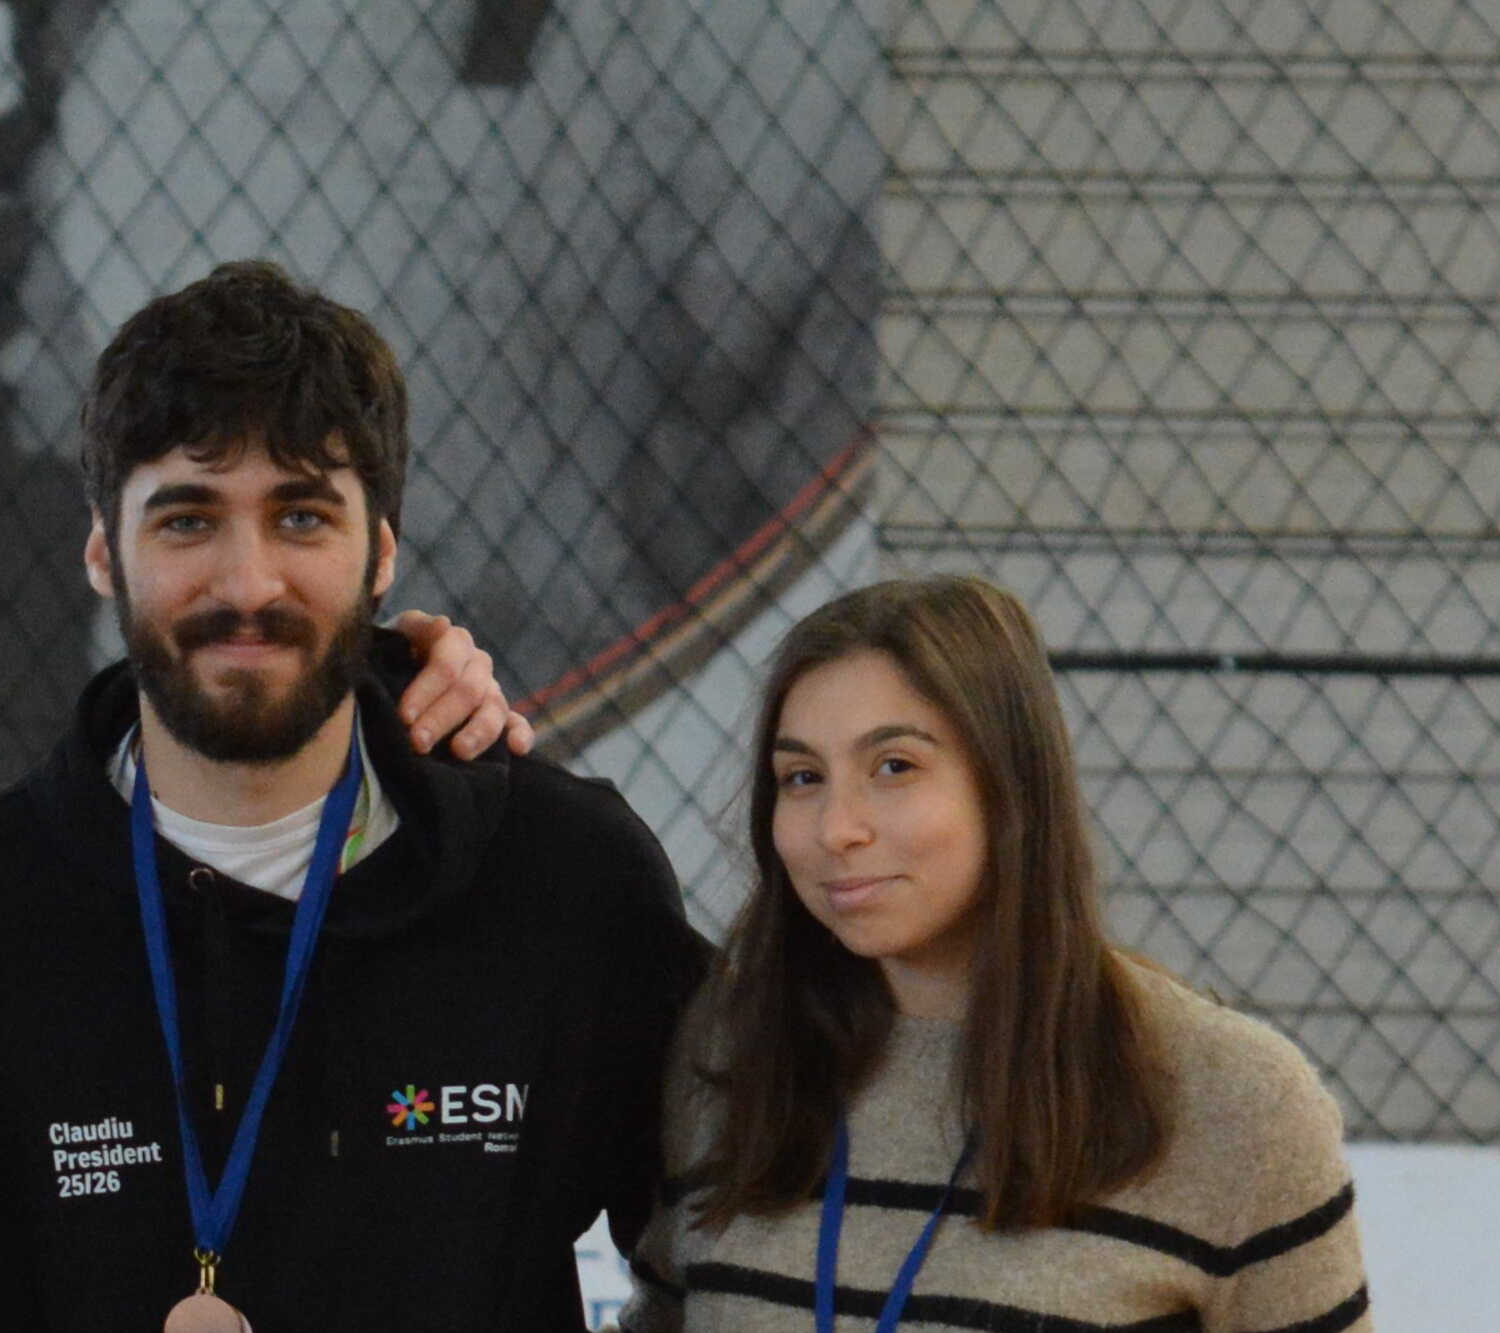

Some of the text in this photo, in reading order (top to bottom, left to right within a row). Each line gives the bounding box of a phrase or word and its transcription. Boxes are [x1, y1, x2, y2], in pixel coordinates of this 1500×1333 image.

[49, 1116, 134, 1145] Claudiu
[438, 1131, 483, 1144] Student
[52, 1141, 162, 1172] President
